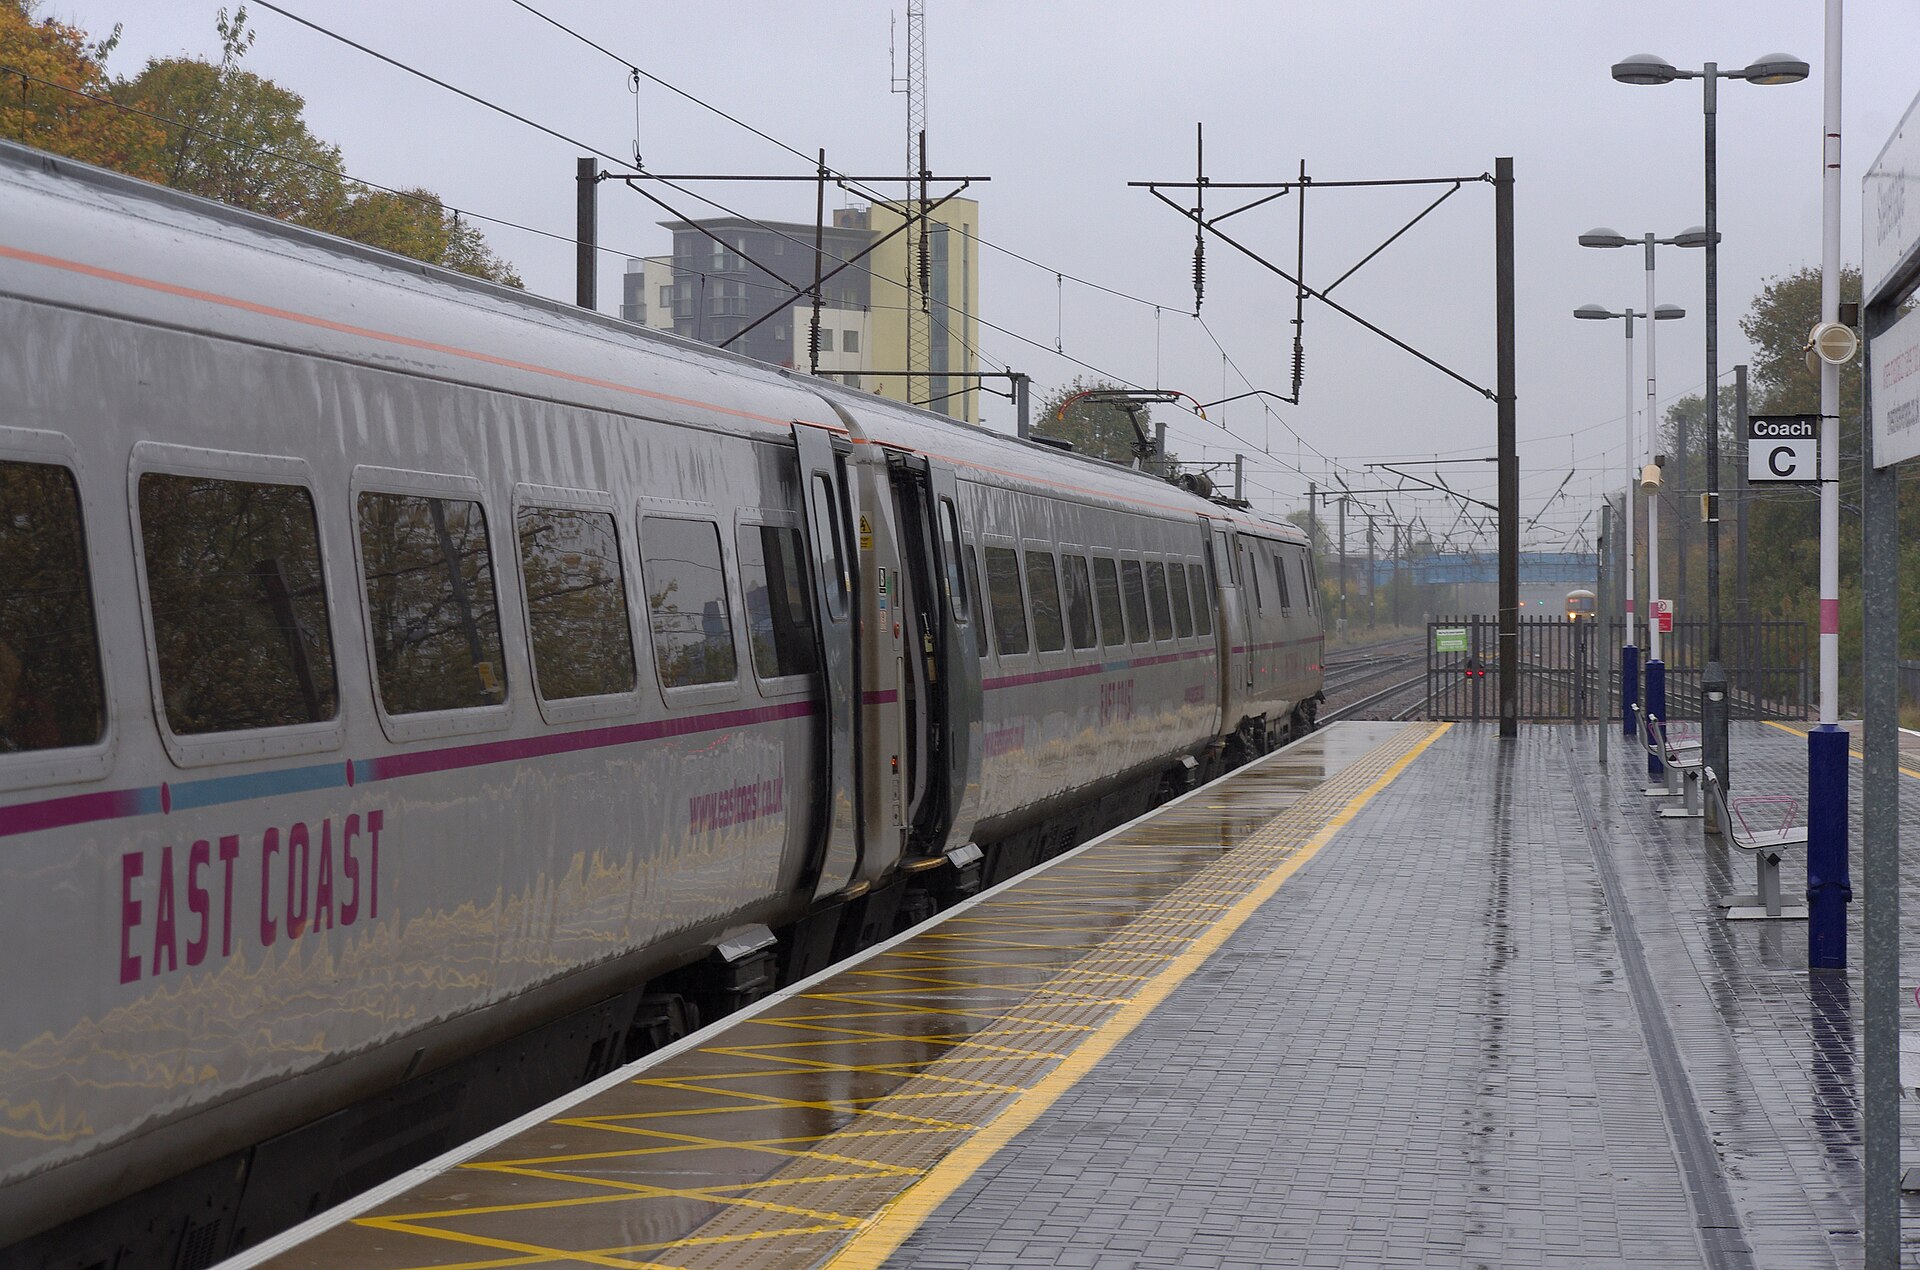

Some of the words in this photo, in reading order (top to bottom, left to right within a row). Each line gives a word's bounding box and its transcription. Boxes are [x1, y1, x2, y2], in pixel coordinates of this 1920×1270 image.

[1753, 420, 1812, 436] Coach
[1768, 446, 1797, 477] C
[120, 834, 240, 984] EAST
[259, 810, 384, 947] COAST
